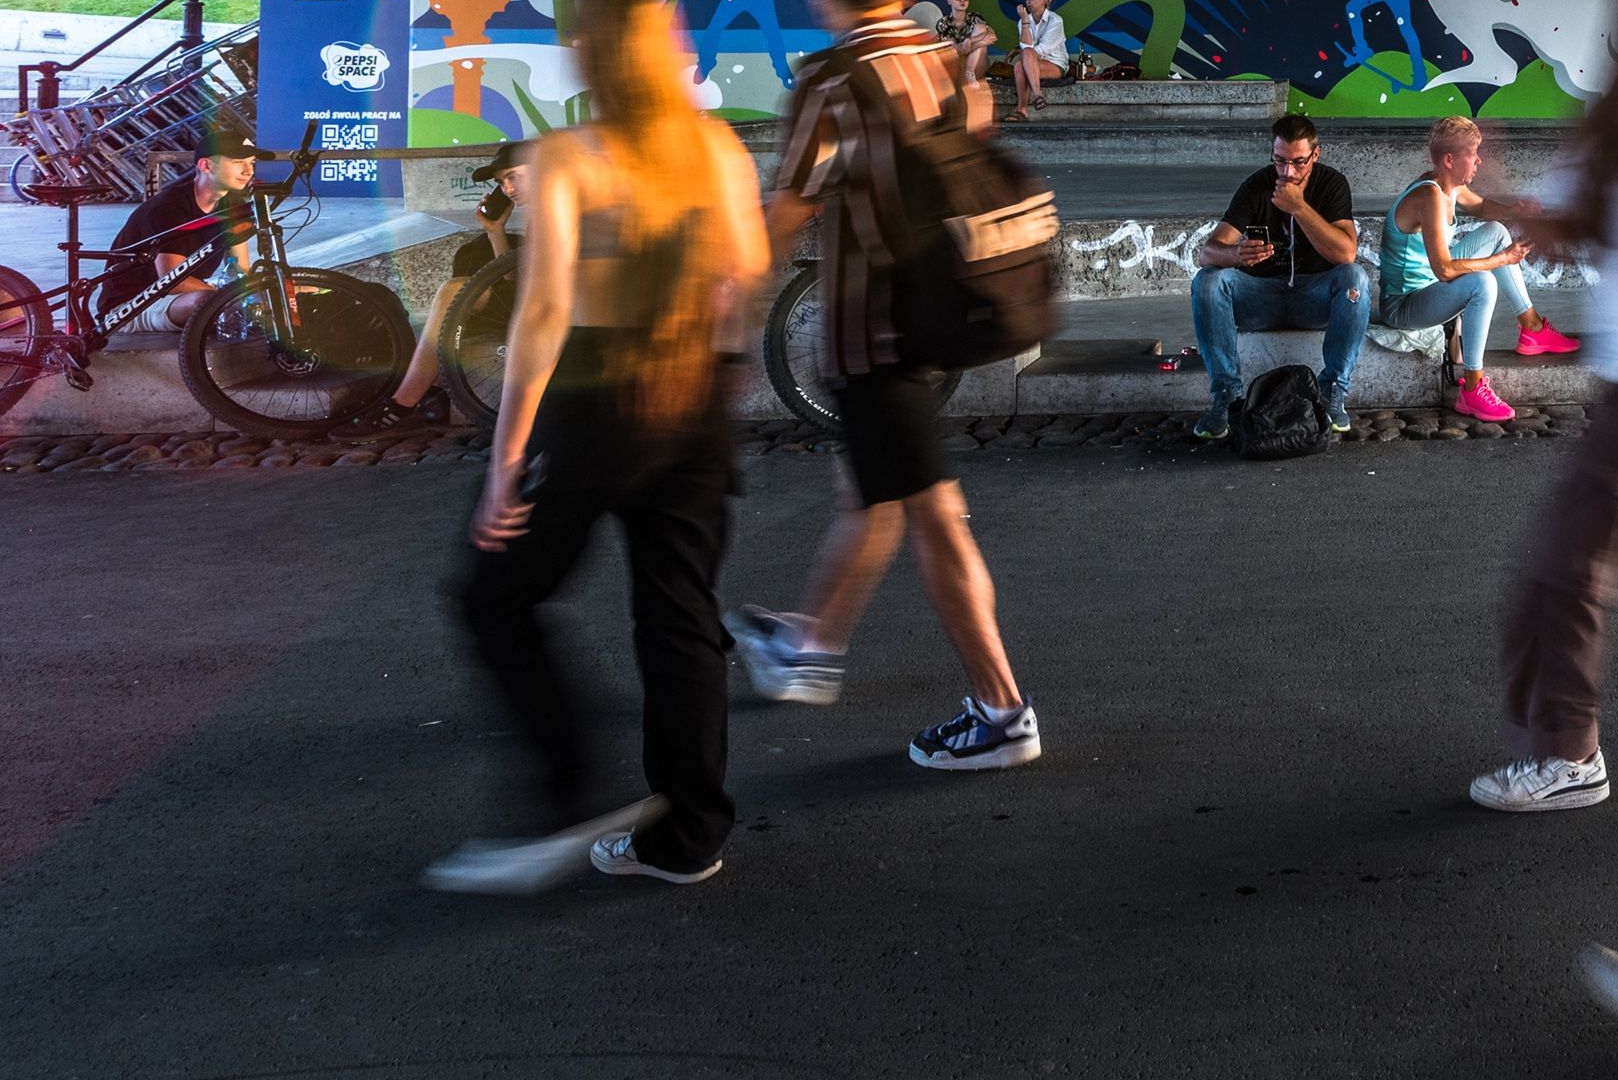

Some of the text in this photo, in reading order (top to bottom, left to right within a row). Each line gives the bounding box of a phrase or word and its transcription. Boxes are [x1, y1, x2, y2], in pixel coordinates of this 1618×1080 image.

[343, 55, 378, 66] PEPSI
[338, 66, 376, 76] SPACE
[303, 109, 401, 121] ZGŁOŚ SWOJĄ PRACĘ NA
[104, 243, 214, 330] ROCKRIDER
